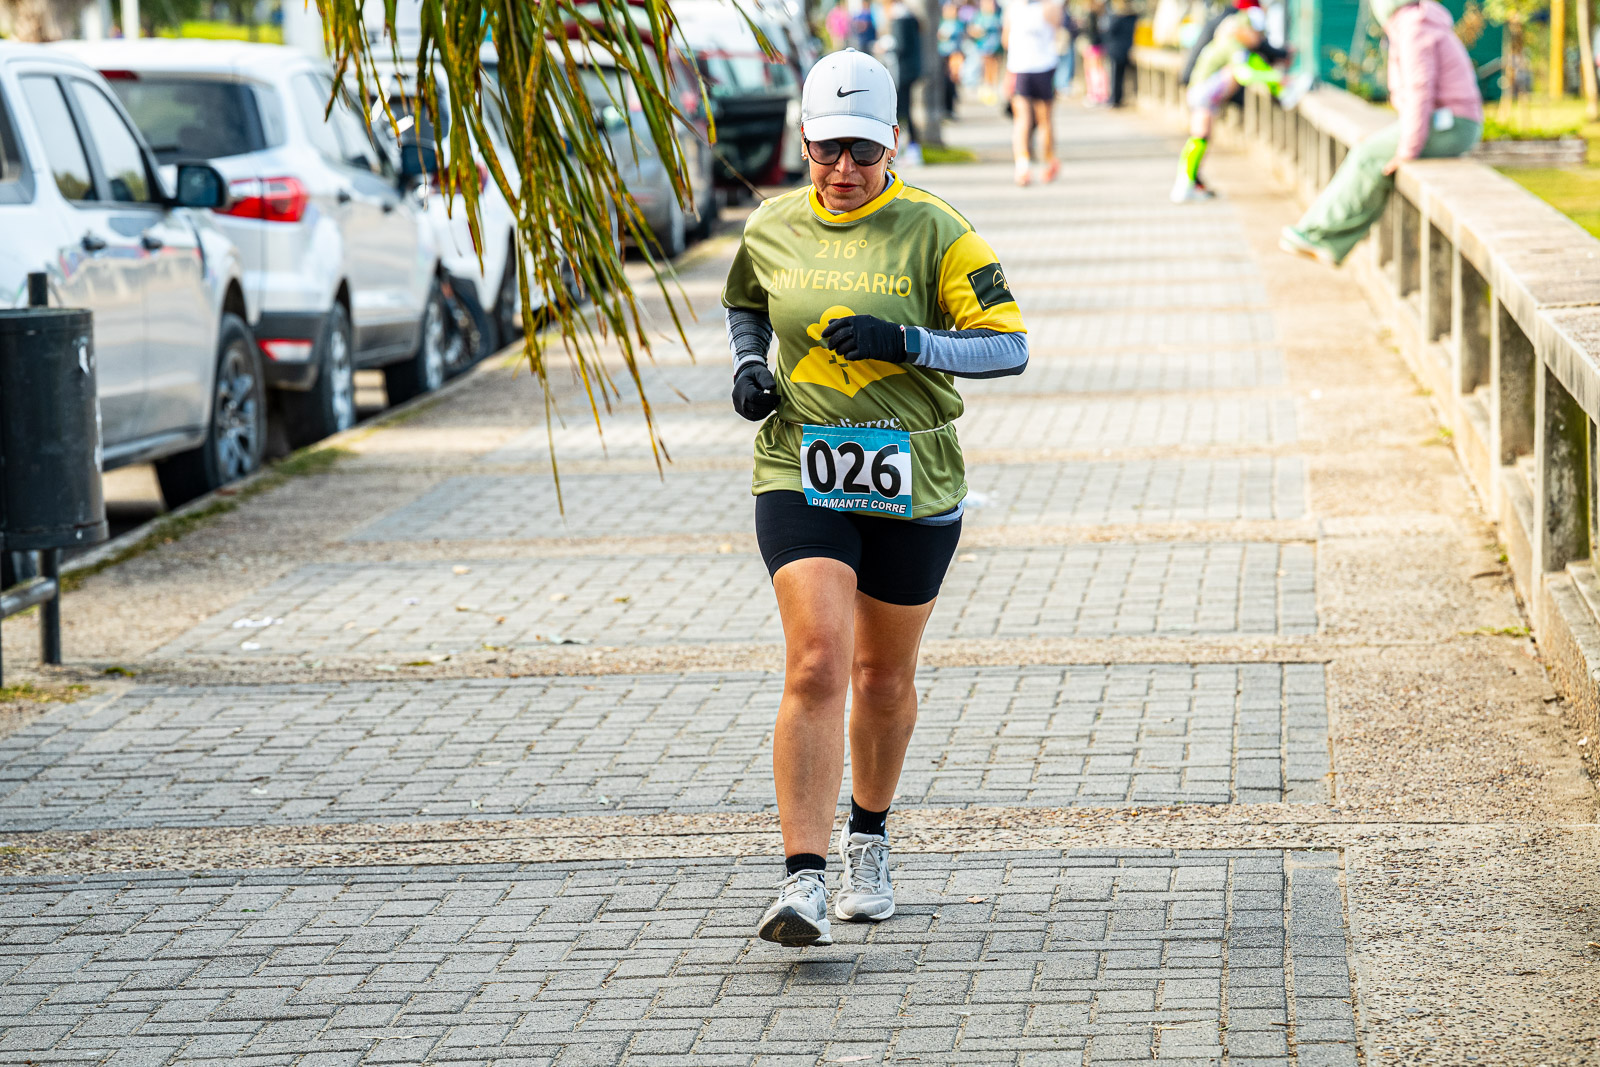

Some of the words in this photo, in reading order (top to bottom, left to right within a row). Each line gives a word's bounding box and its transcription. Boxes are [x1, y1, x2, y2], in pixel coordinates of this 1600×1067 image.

[815, 239, 868, 259] 216°
[768, 268, 913, 298] ANIVERSARIO
[808, 439, 902, 499] 026
[812, 498, 868, 509] DIAMANTE
[871, 500, 907, 514] CORRE
